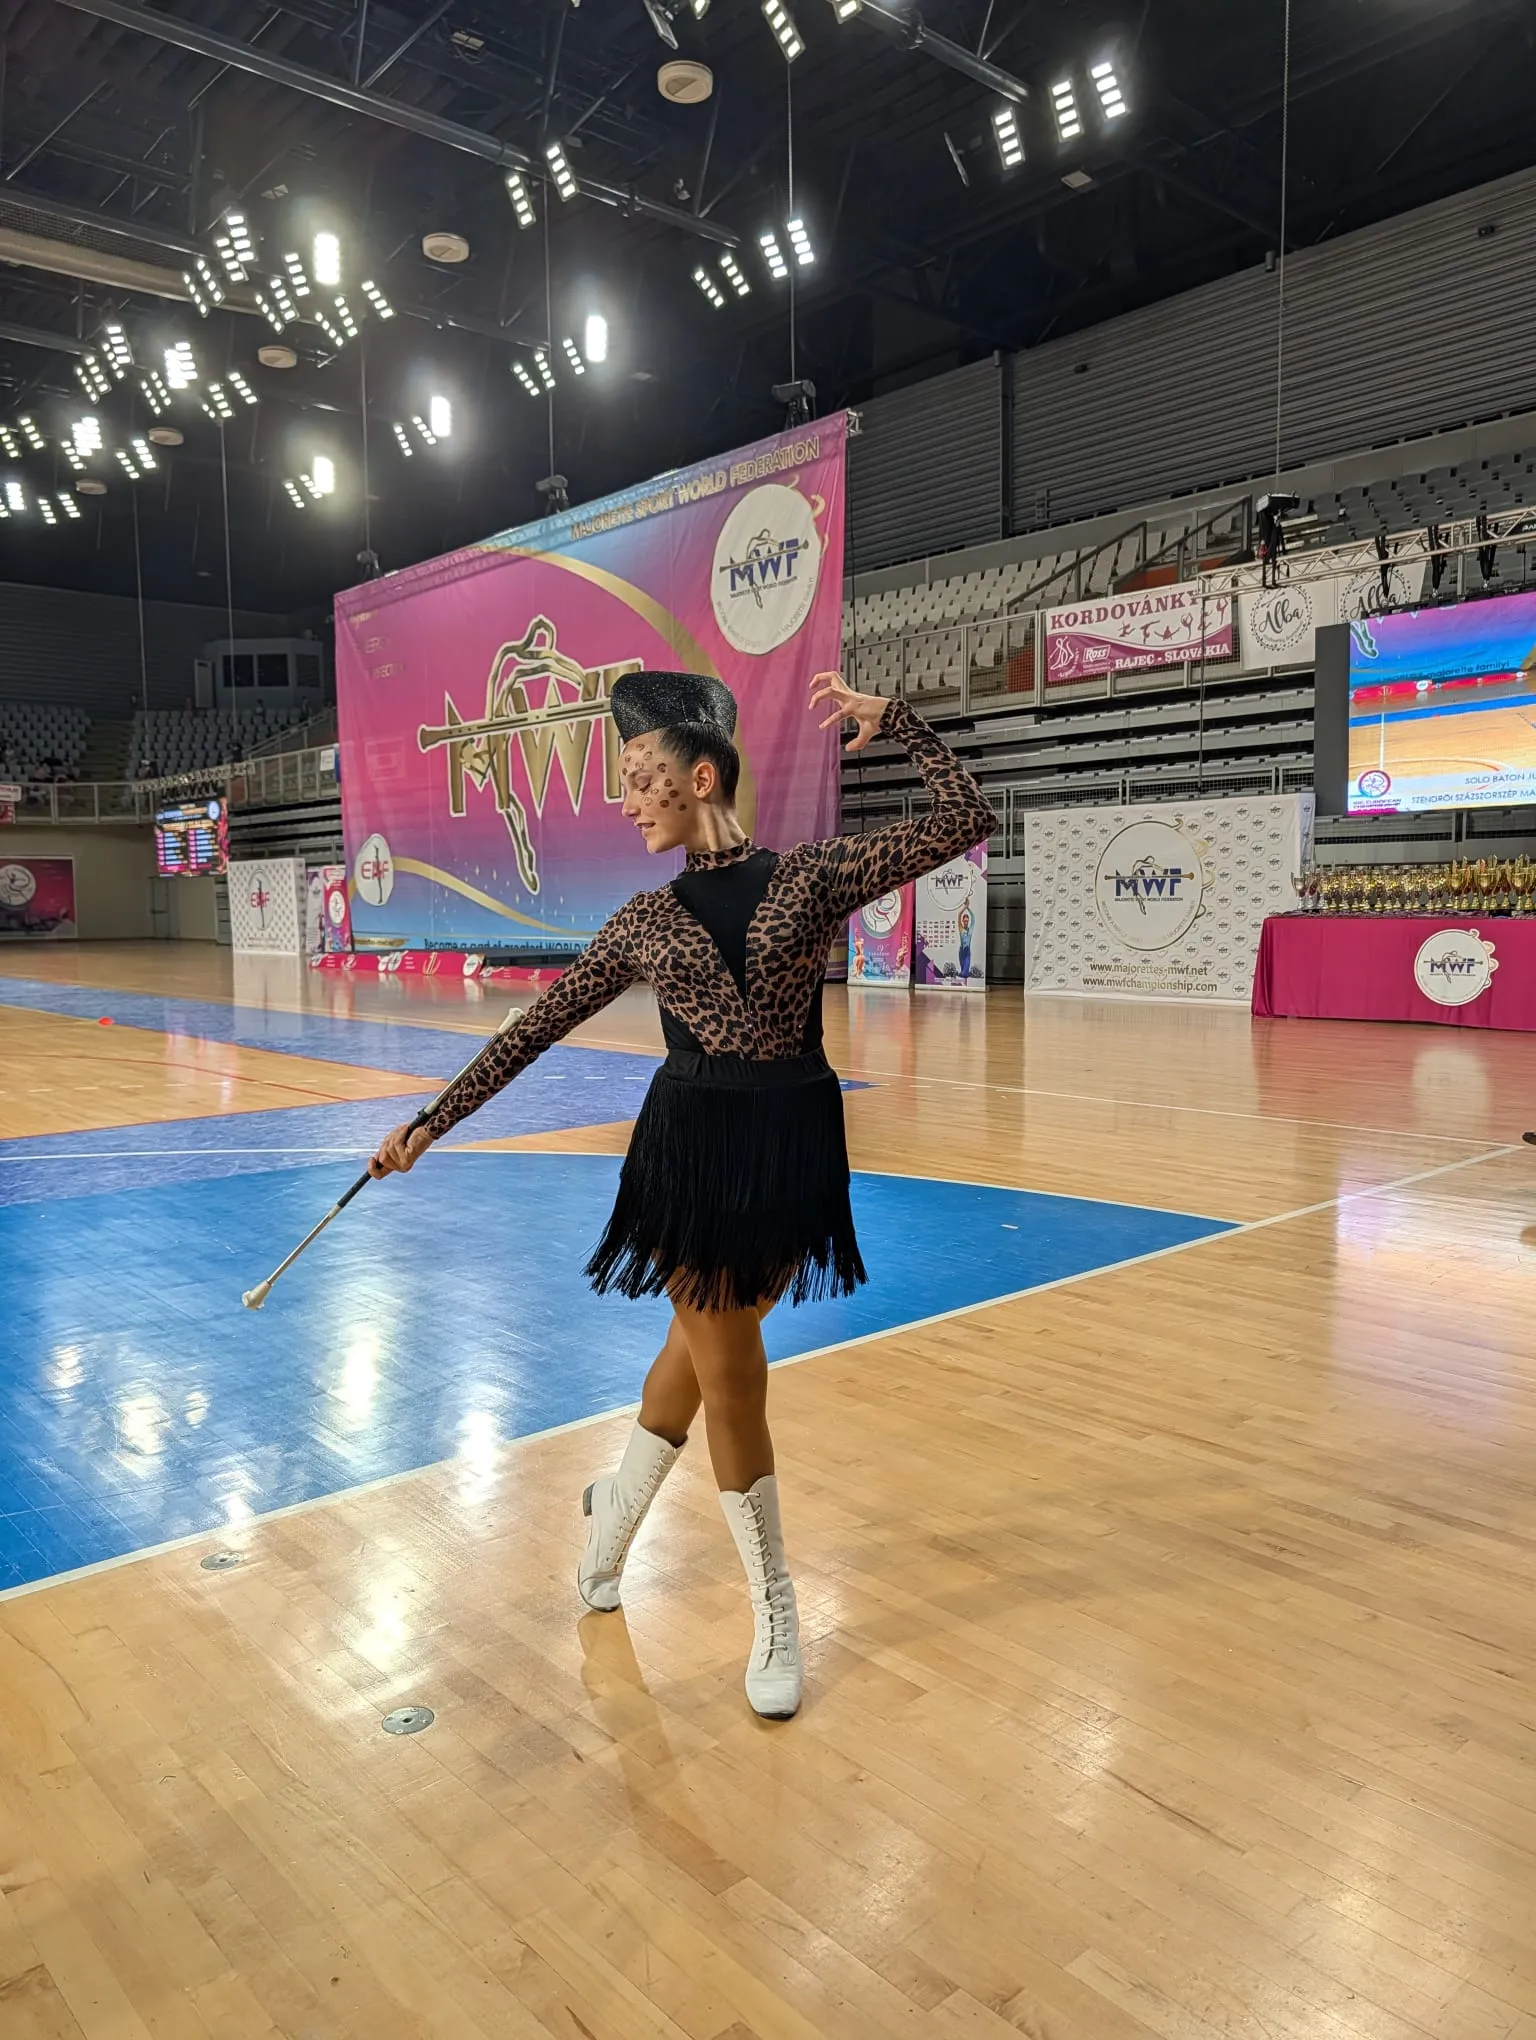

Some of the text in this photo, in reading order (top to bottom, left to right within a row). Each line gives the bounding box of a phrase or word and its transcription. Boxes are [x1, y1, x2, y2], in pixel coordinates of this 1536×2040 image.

[677, 470, 727, 505] WORLD
[729, 435, 820, 488] FEDERATION
[1050, 589, 1200, 630] KORDOVÁNKY
[1258, 598, 1304, 634] Alba
[1115, 653, 1155, 670] RAJEC
[1164, 643, 1231, 662] SLOVAKIA
[1464, 776, 1490, 785] SOLO
[1492, 773, 1525, 783] BATON
[1115, 867, 1182, 897] MWF
[1089, 963, 1208, 976] www.majorettes-mwf.net
[1430, 957, 1476, 974] MWF
[1082, 977, 1218, 993] www.mwfchampionship.com
